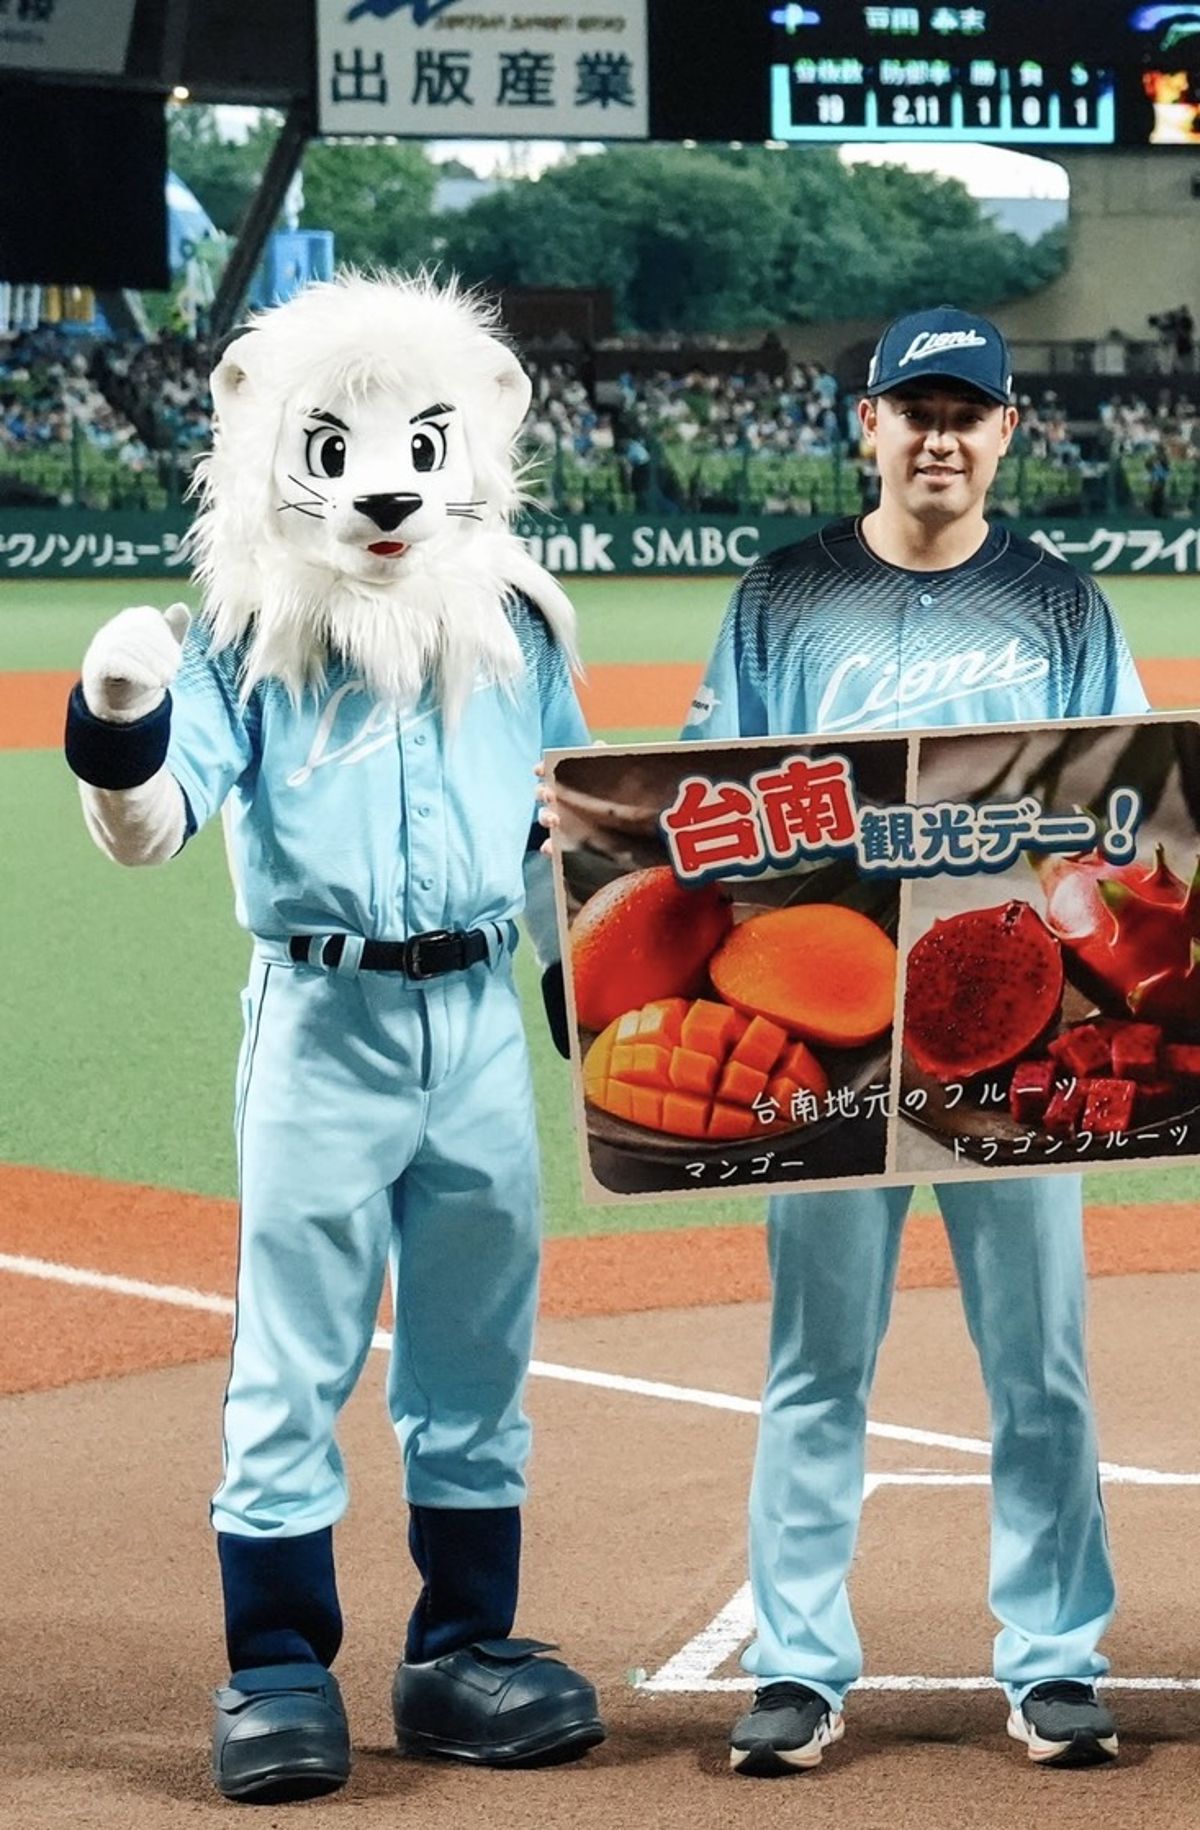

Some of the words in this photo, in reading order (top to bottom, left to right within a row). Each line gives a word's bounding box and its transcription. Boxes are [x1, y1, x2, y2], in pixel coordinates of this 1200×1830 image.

[331, 49, 636, 108] 出版産業
[893, 95, 939, 125] 2.11
[977, 96, 990, 125] 1
[1022, 96, 1041, 126] 0
[1074, 97, 1087, 126] 1
[898, 329, 987, 367] Lions
[632, 526, 760, 567] SMBC
[817, 638, 1050, 733] Lions
[751, 1076, 1077, 1125] 台南地元のフルーツ
[950, 1125, 1189, 1163] ドラゴンフルーツ
[685, 1156, 805, 1180] マンゴー
